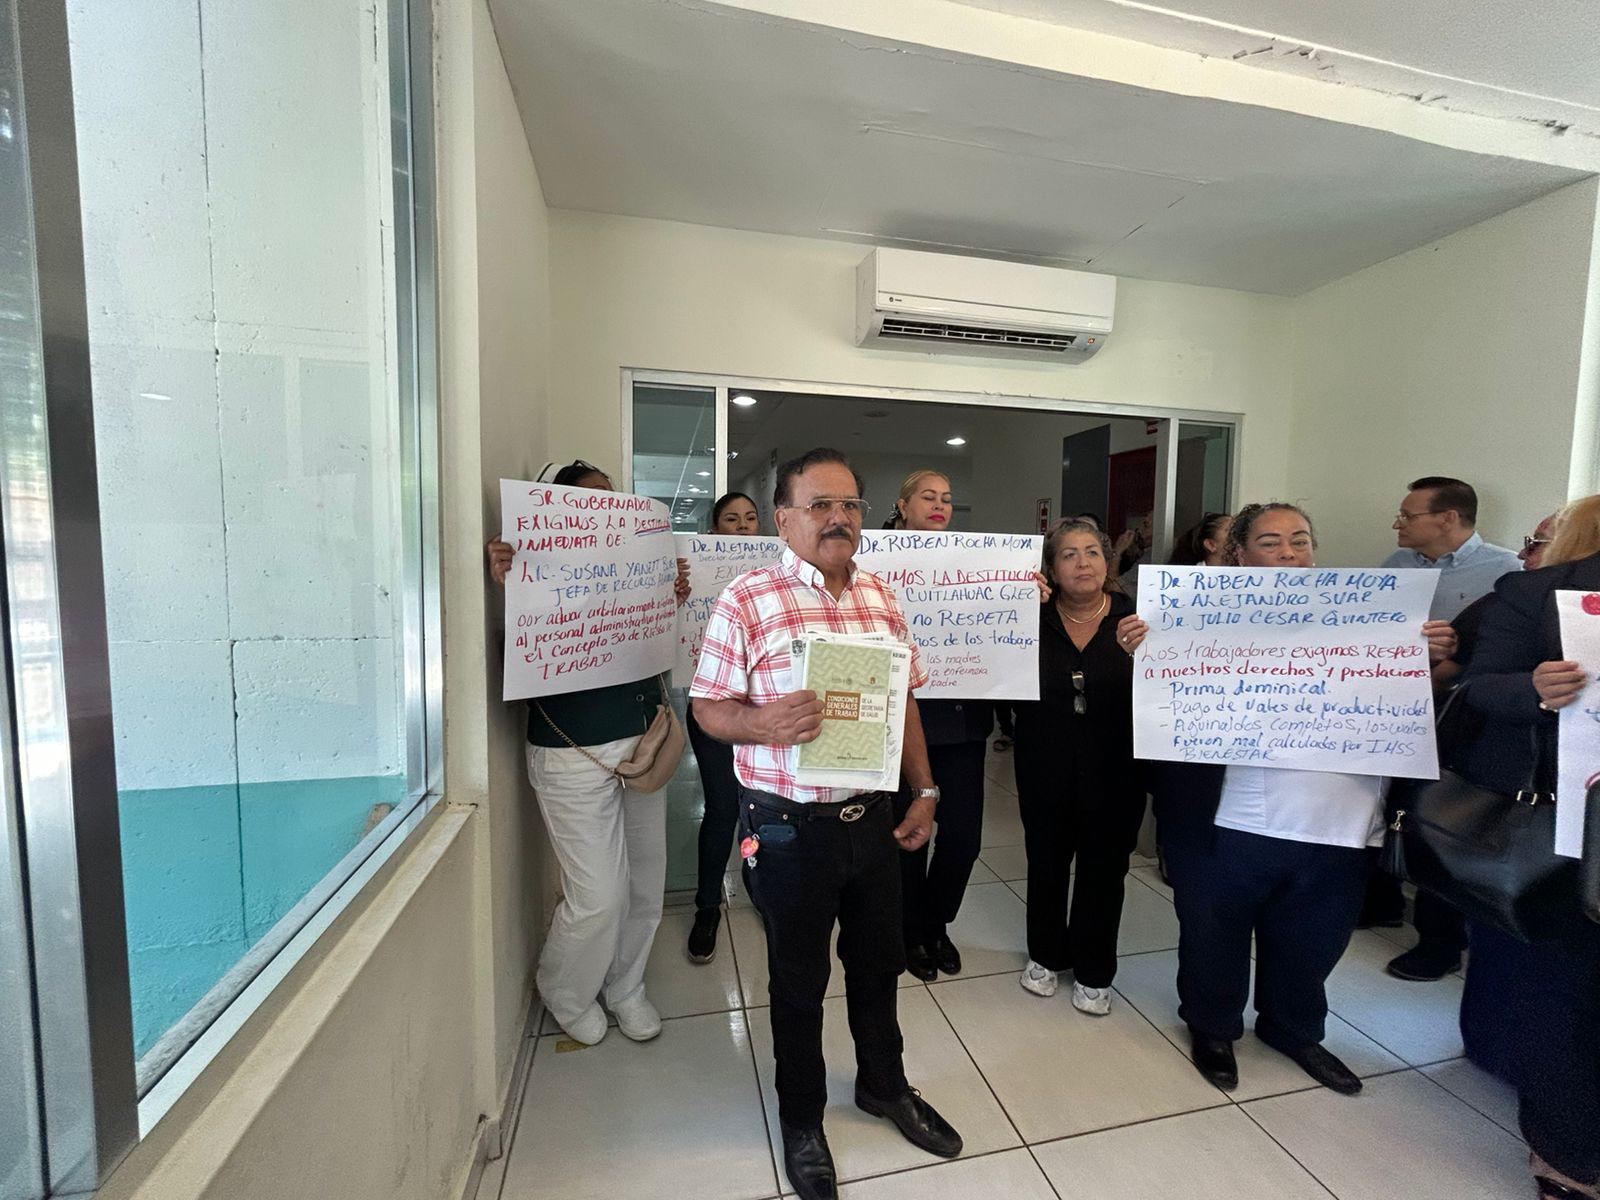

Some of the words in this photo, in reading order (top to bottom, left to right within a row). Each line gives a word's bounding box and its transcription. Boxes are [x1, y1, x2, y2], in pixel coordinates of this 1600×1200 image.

[516, 513, 599, 532] EXIGIMOS
[605, 514, 627, 530] LA
[517, 535, 598, 552] INMEDIATA
[715, 540, 779, 554] ALEJANDRO
[884, 534, 949, 552] RUBEN
[951, 533, 997, 549] ROCHA
[1001, 535, 1033, 551] MOYA
[560, 562, 618, 582] SUSANA
[932, 569, 951, 587] LA
[1193, 571, 1264, 590] RUBEN
[1273, 571, 1338, 588] ROCHA
[549, 585, 591, 607] JEFA
[596, 581, 610, 596] DE
[905, 586, 995, 603] CUITLAHUAC
[1190, 590, 1310, 610] ALEJANDRO
[937, 608, 1019, 628] RESPETA
[1199, 611, 1242, 632] JULIO
[1249, 611, 1314, 625] CESAR
[516, 631, 528, 649] al
[534, 622, 585, 652] personal
[523, 647, 543, 664] el
[627, 629, 641, 642] de
[943, 632, 959, 647] de
[964, 631, 984, 646] los
[945, 651, 982, 666] madres
[1141, 641, 1179, 663] Los
[1183, 640, 1286, 665] trabajadores
[1290, 645, 1360, 668] exigimos
[1144, 667, 1155, 680] a
[1161, 661, 1231, 680] nuestros
[1236, 659, 1315, 678] derechos
[826, 702, 858, 710] GENERALES
[834, 709, 858, 717] TRABAJO
[1215, 698, 1237, 713] de
[1294, 698, 1313, 714] de
[1174, 715, 1263, 738] Aguinaldos
[1231, 732, 1264, 748] mal
[1267, 733, 1337, 752] calculados
[1179, 746, 1277, 762] BIENESTAR
